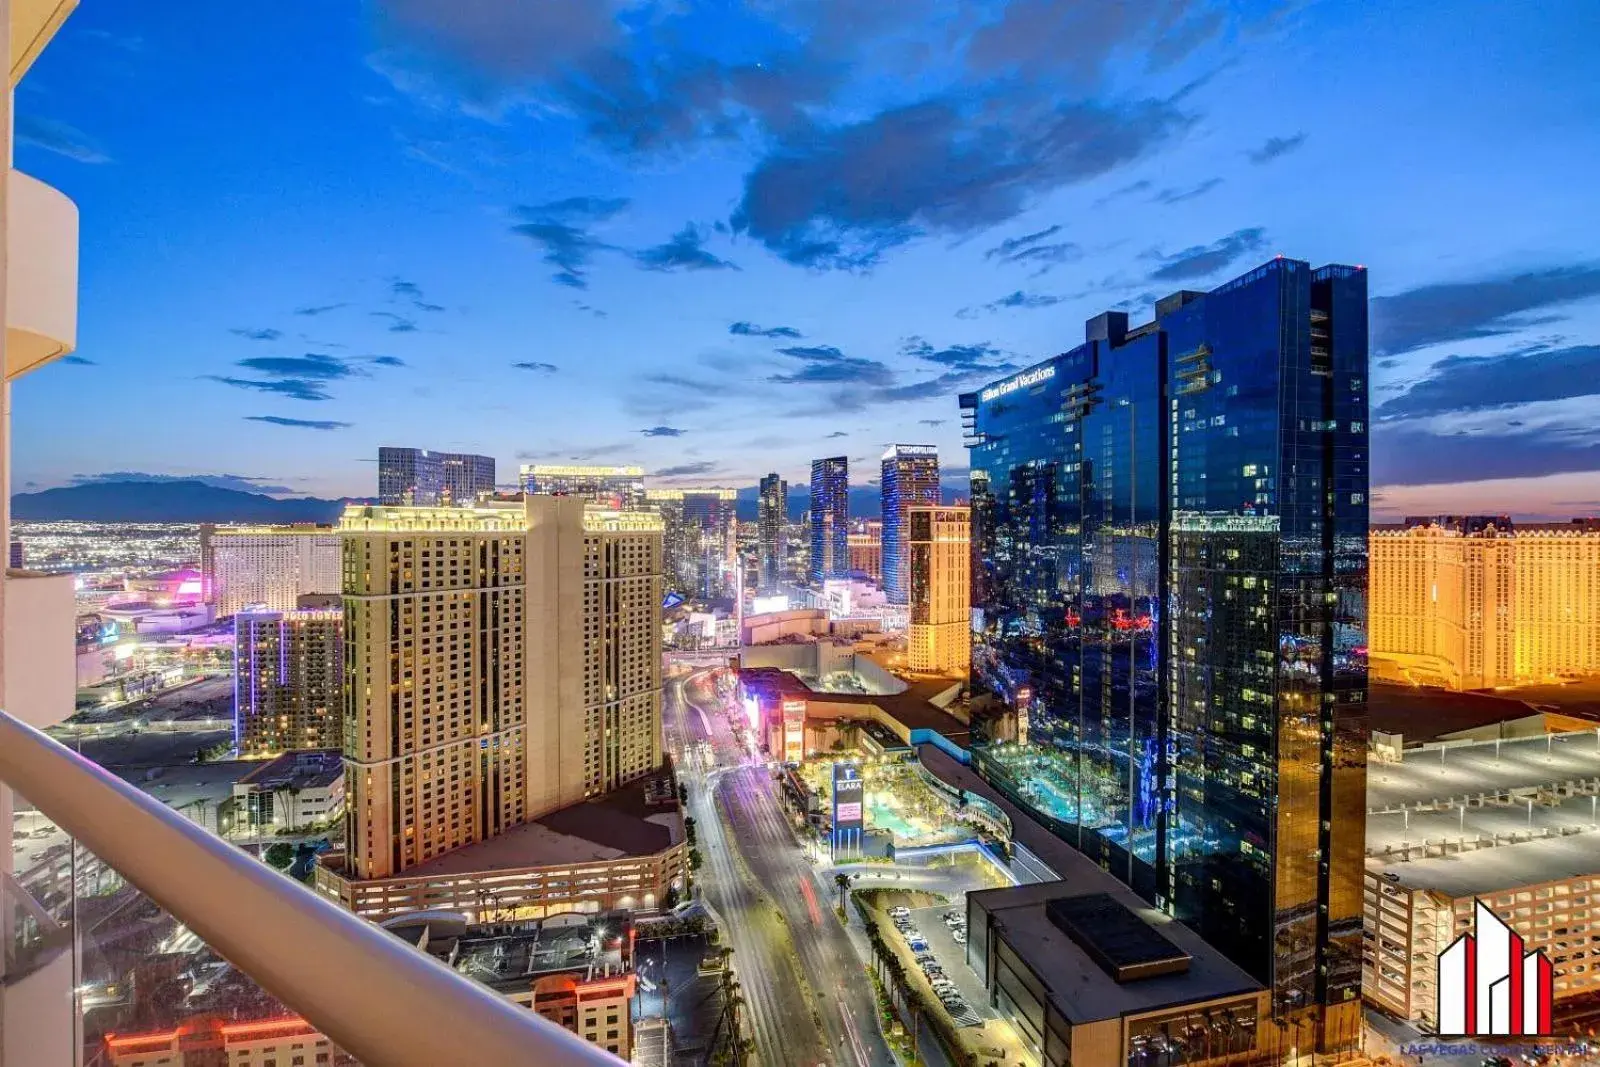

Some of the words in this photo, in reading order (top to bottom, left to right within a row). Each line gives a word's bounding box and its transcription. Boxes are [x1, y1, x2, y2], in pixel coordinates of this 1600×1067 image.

[1000, 377, 1019, 396] Grand
[1019, 366, 1056, 387] Vacations
[837, 782, 862, 791] ELARA
